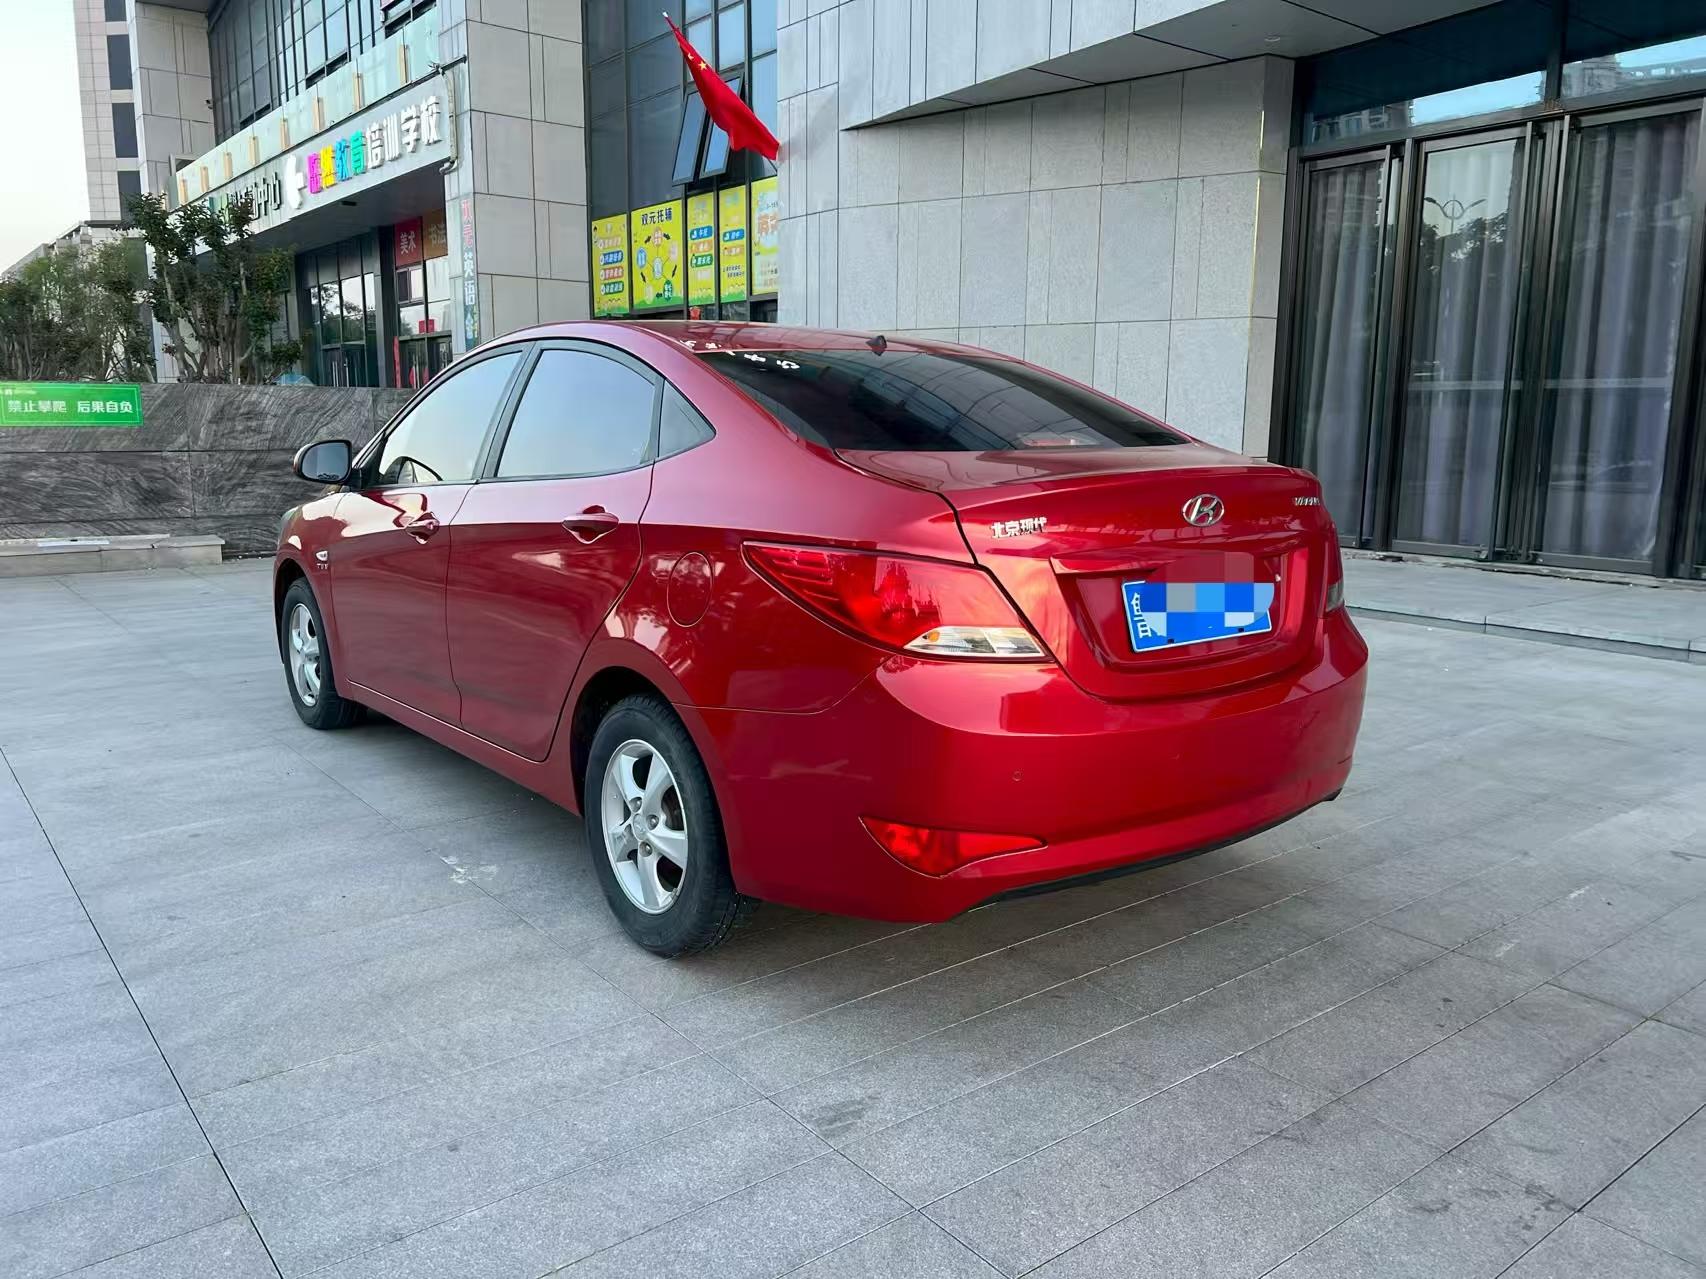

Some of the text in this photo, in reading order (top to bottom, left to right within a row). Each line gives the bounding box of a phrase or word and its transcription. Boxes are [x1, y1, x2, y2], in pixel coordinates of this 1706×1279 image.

[400, 231, 416, 255] 美术
[77, 400, 133, 414] 后果自负
[991, 516, 1047, 539] 北京现代
